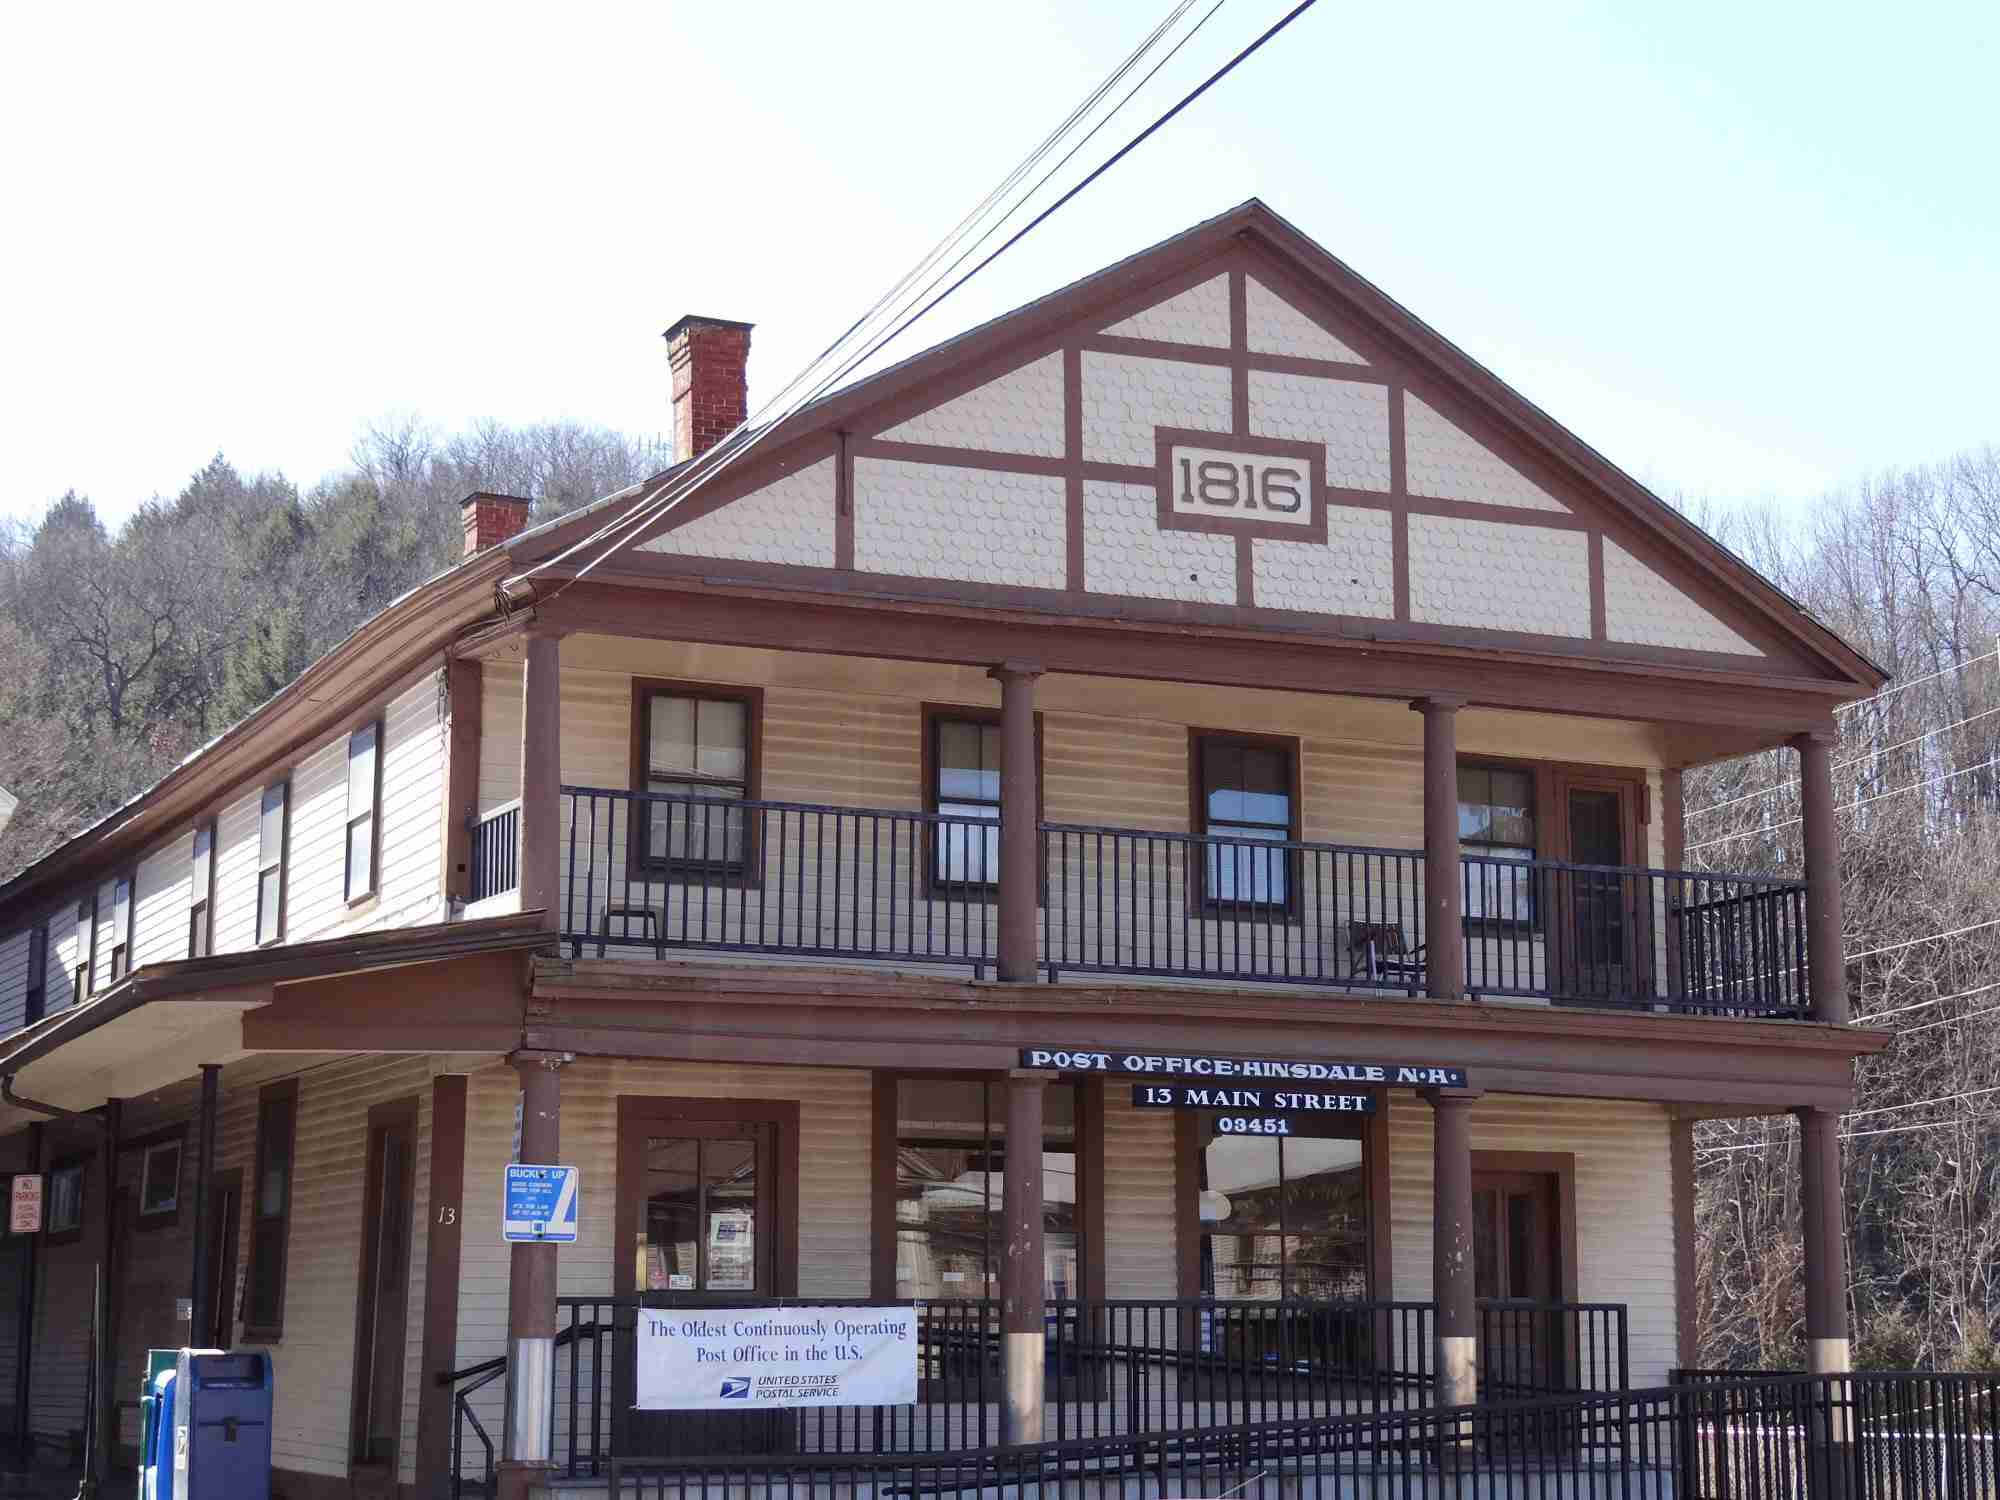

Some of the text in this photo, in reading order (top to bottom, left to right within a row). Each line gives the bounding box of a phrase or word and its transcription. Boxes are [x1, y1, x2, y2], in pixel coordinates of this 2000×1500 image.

[1180, 458, 1301, 513] 1816
[1031, 1050, 1113, 1069] POST
[1146, 1087, 1367, 1112] 13 MAIN STREET
[1219, 1116, 1289, 1134] 03451
[510, 1168, 566, 1180] BUCKLE UP
[438, 1206, 456, 1225] 13
[649, 1319, 907, 1341] The Oldest Continuously Operating
[696, 1344, 863, 1362] Post Office in the U.S.
[758, 1374, 840, 1386] UNITED STATES
[755, 1387, 840, 1399] POSTAL SERVICE
